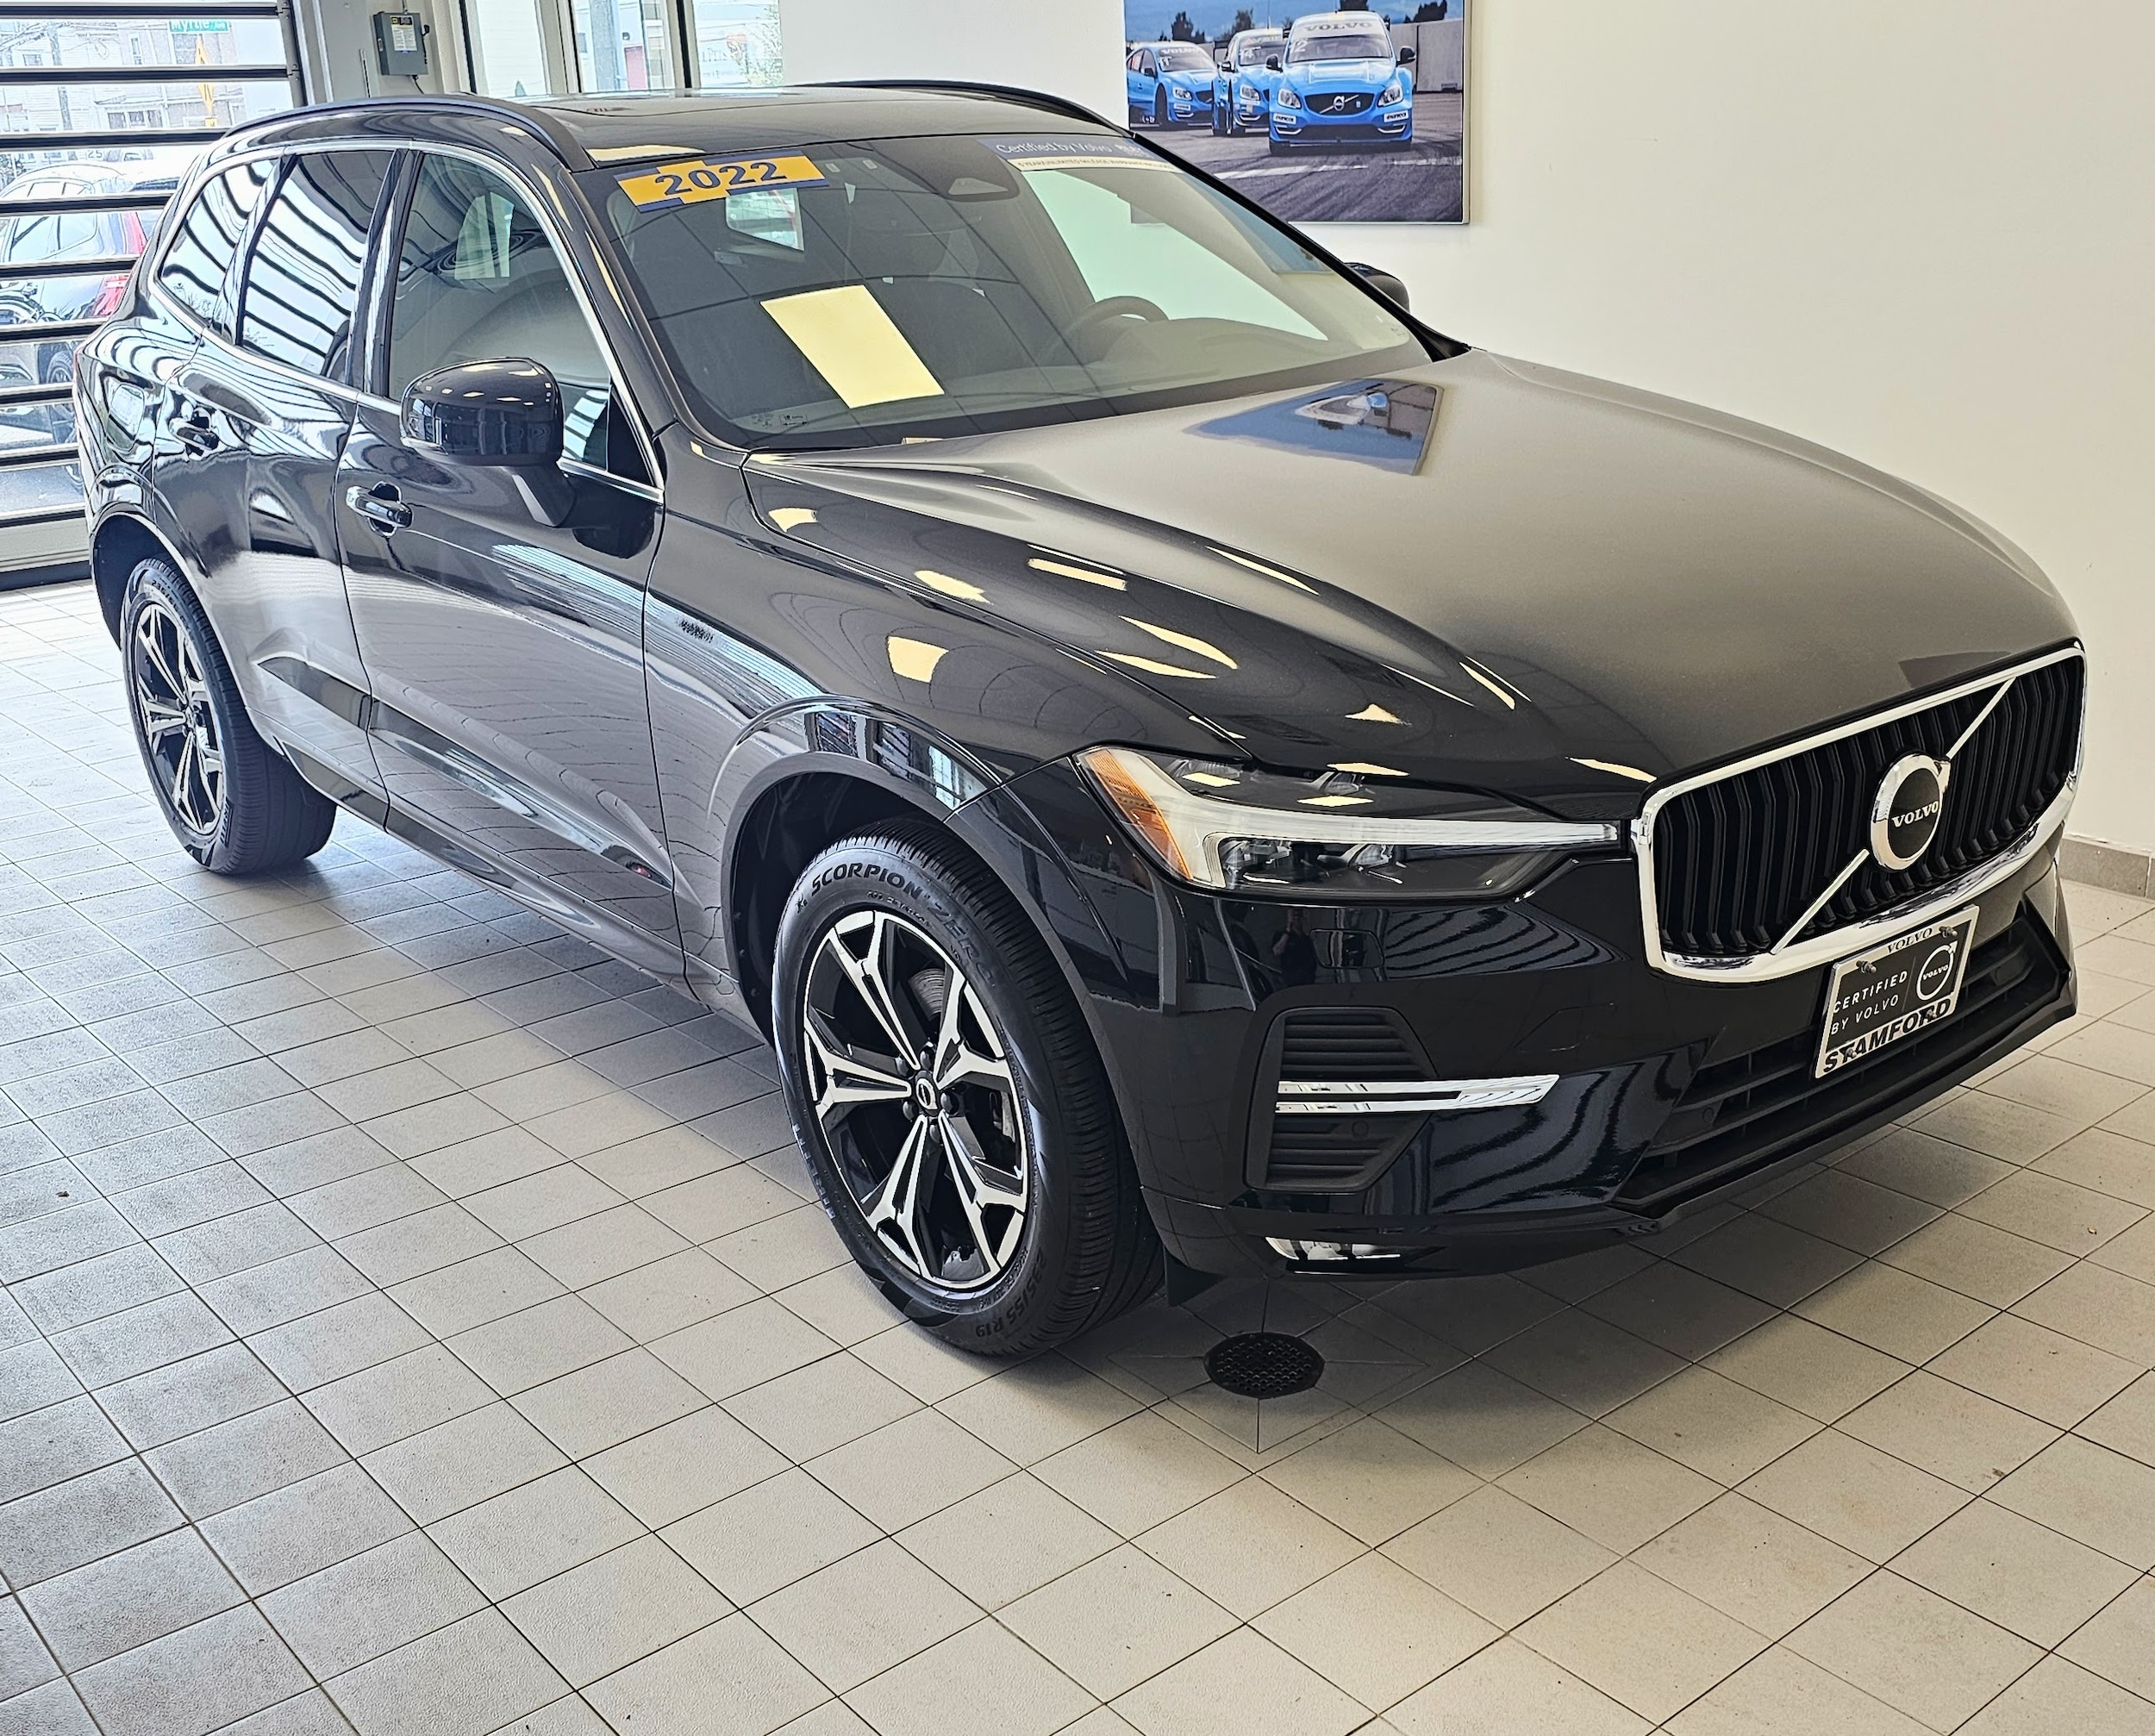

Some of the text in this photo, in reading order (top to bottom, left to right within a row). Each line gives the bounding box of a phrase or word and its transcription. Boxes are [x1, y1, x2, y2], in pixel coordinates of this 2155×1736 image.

[1304, 22, 1372, 32] VOLVO
[655, 162, 787, 196] 2022
[1891, 801, 1939, 827] VOLVO
[811, 862, 924, 900] SCORPION
[1887, 927, 1933, 953] VOLVO
[1923, 965, 1949, 981] VOLVO
[1833, 971, 1908, 1013] CERTIFIED
[1831, 995, 1899, 1035] BY VOLVO
[1823, 998, 1952, 1072] STAMFORD
[976, 1317, 1004, 1338] R19
